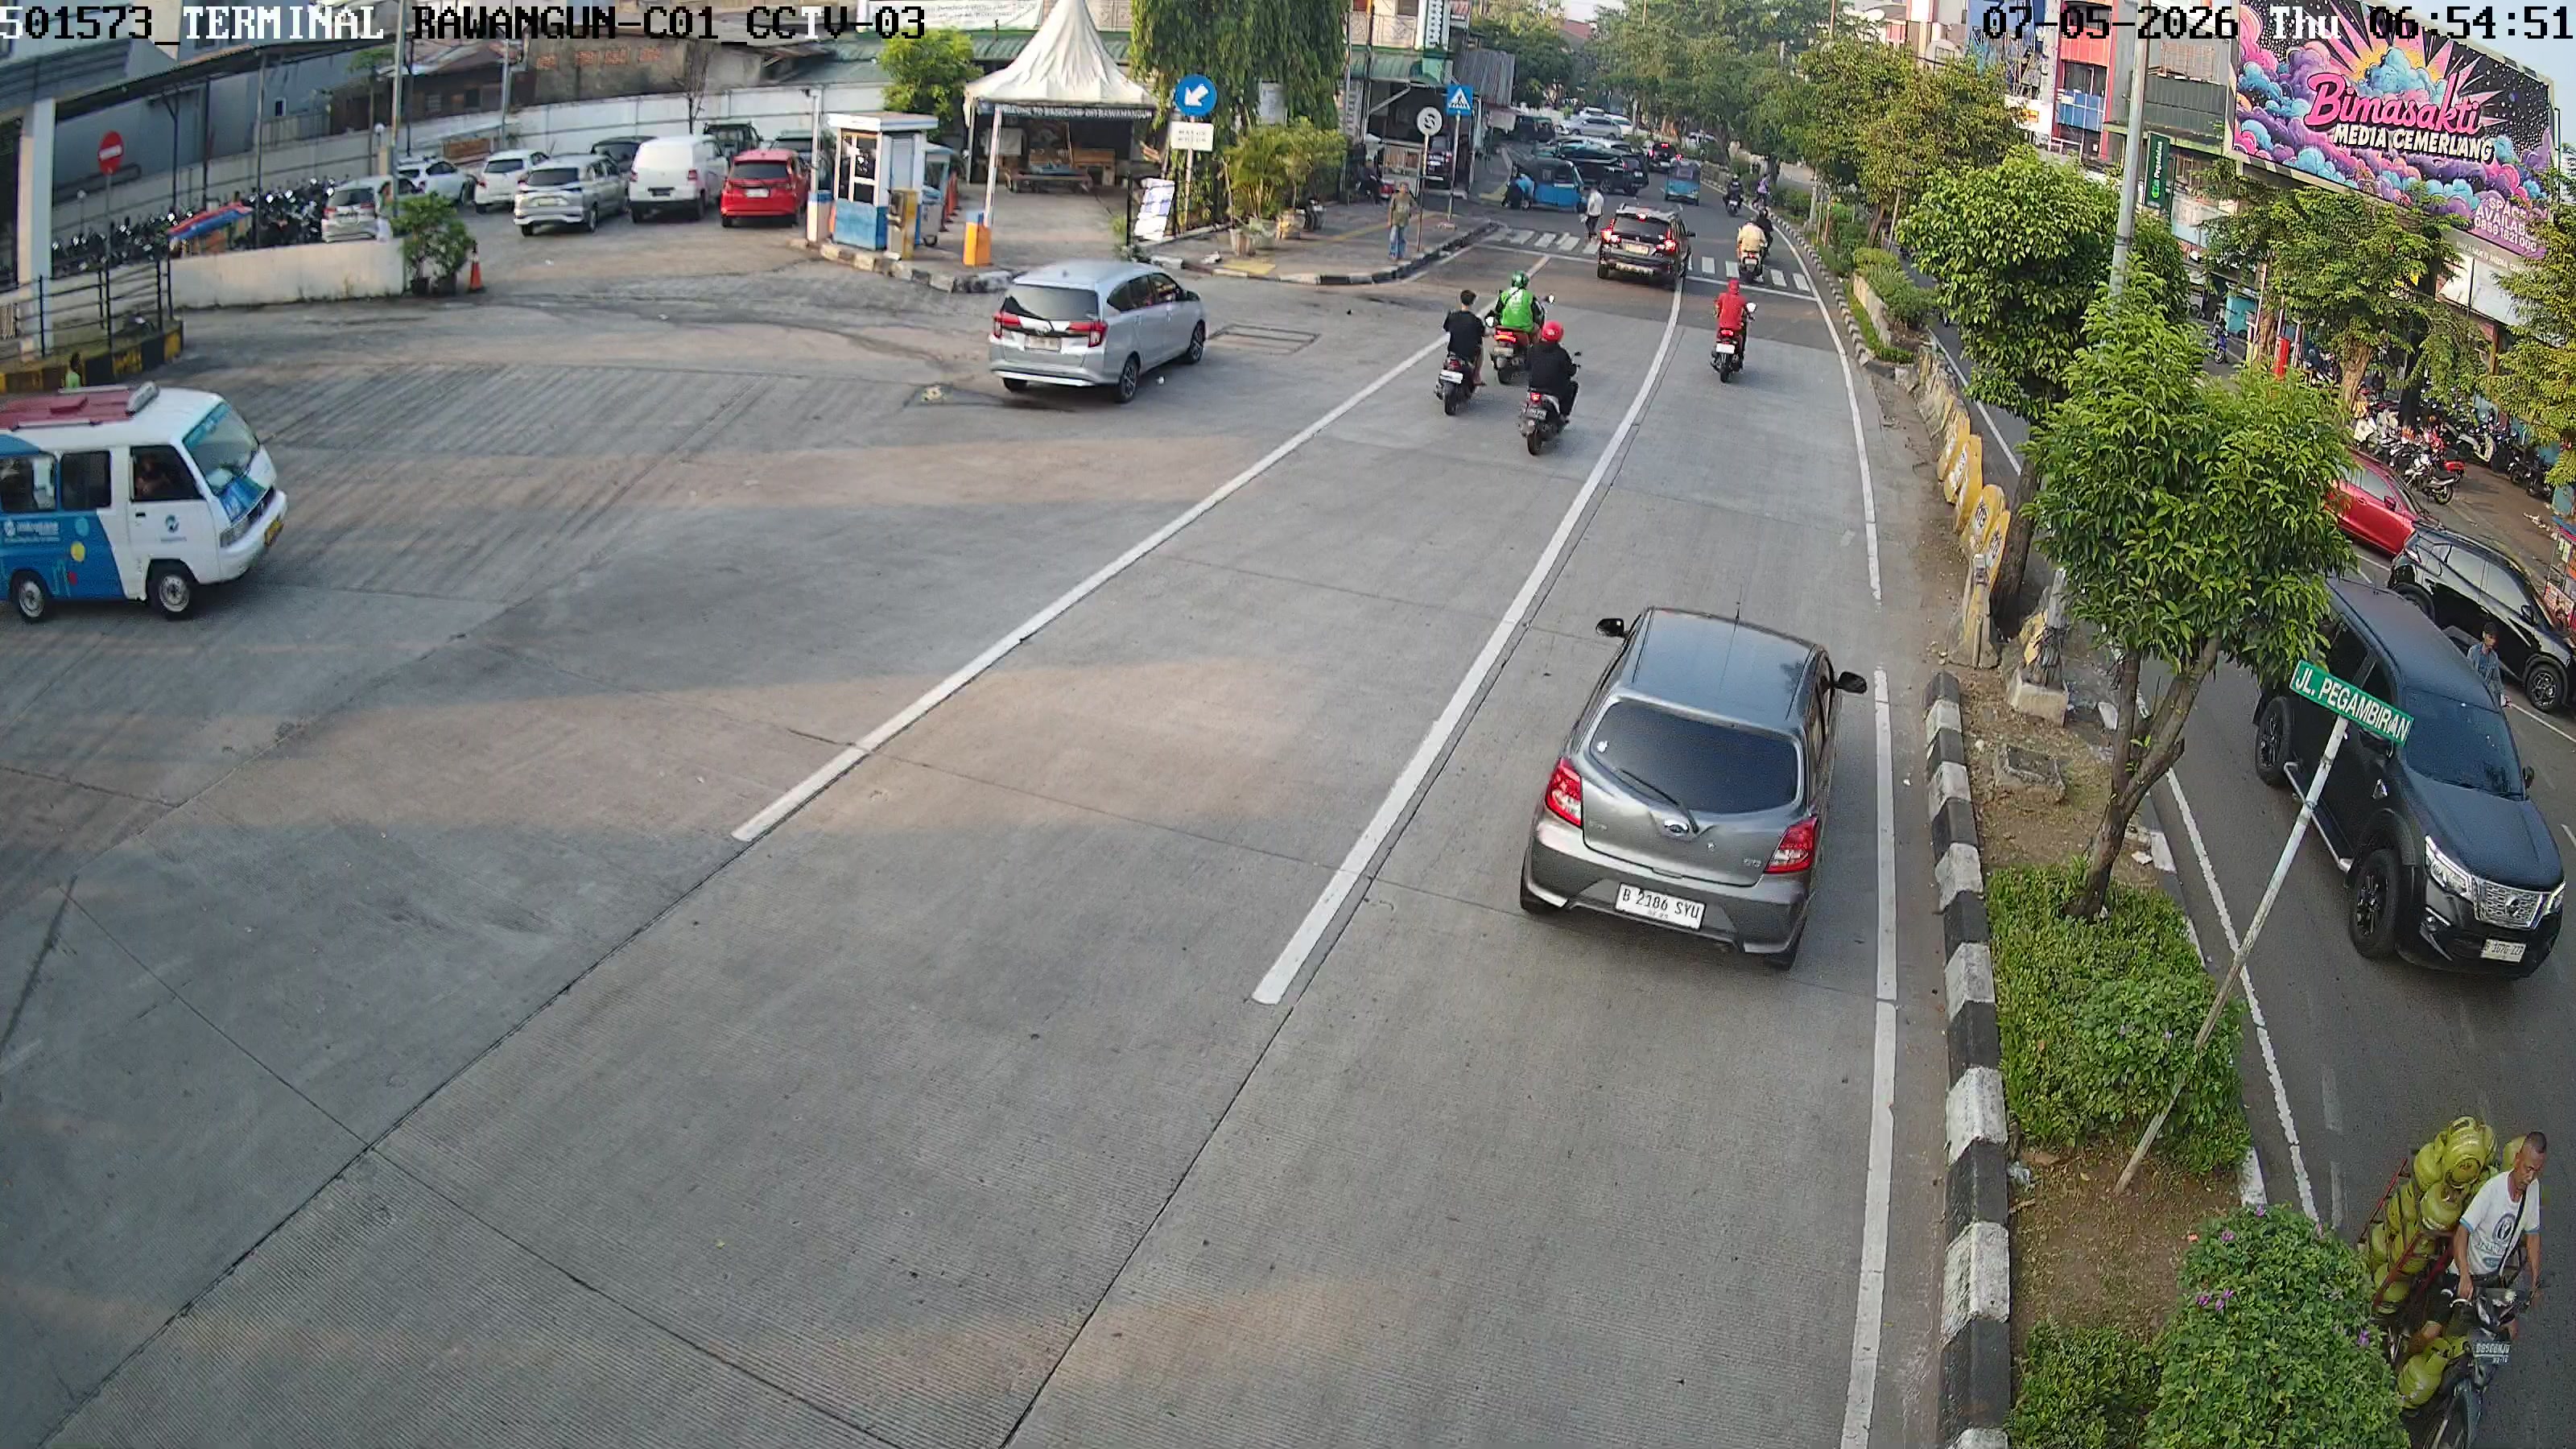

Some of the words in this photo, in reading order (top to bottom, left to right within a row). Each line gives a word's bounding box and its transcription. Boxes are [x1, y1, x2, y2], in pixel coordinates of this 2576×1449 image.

[2304, 72, 2481, 135] Bimasakti
[2334, 124, 2388, 149] MEDIA
[2392, 129, 2494, 161] CEMERLANG
[2295, 667, 2316, 696] JL.
[2318, 677, 2411, 742] PEGAMBIRAN
[1623, 888, 1631, 902] B
[1674, 901, 1699, 919] SYU
